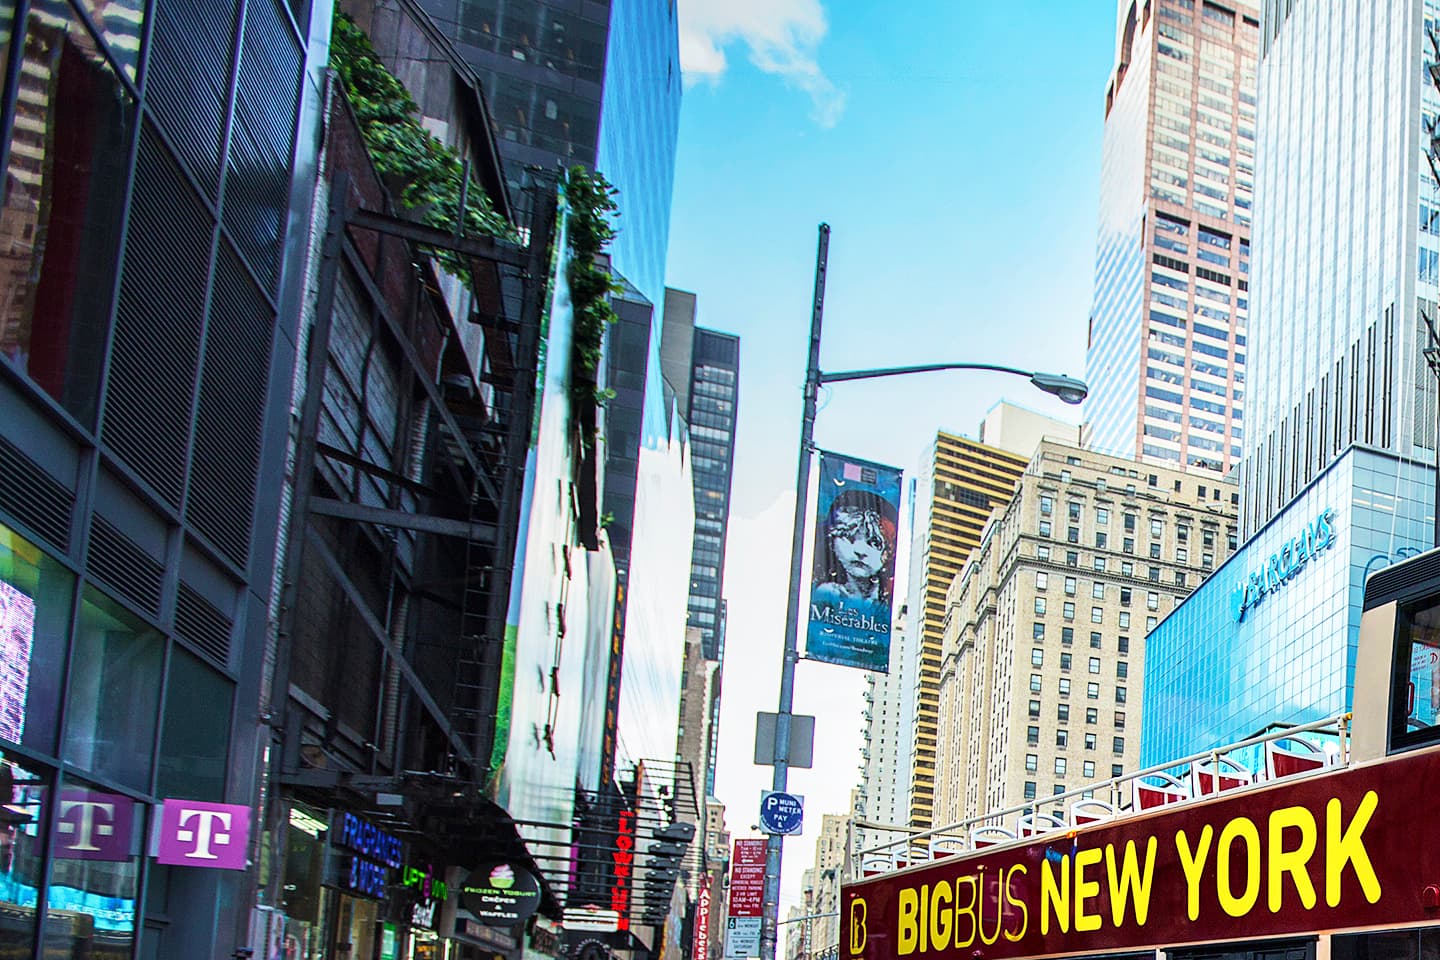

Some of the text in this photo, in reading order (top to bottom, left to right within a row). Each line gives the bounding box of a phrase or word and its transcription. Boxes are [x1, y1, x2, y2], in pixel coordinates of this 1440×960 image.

[1246, 507, 1333, 606] BARCLAYS
[839, 601, 859, 616] Les
[779, 799, 797, 807] MUNI
[779, 806, 802, 815] METER
[773, 814, 788, 822] PAY
[1040, 835, 1158, 937] NEW
[1175, 790, 1382, 922] YORK
[403, 864, 448, 901] UPTOWN
[464, 887, 537, 897] FROZEN YOGURT
[480, 910, 519, 919] WAFFLES
